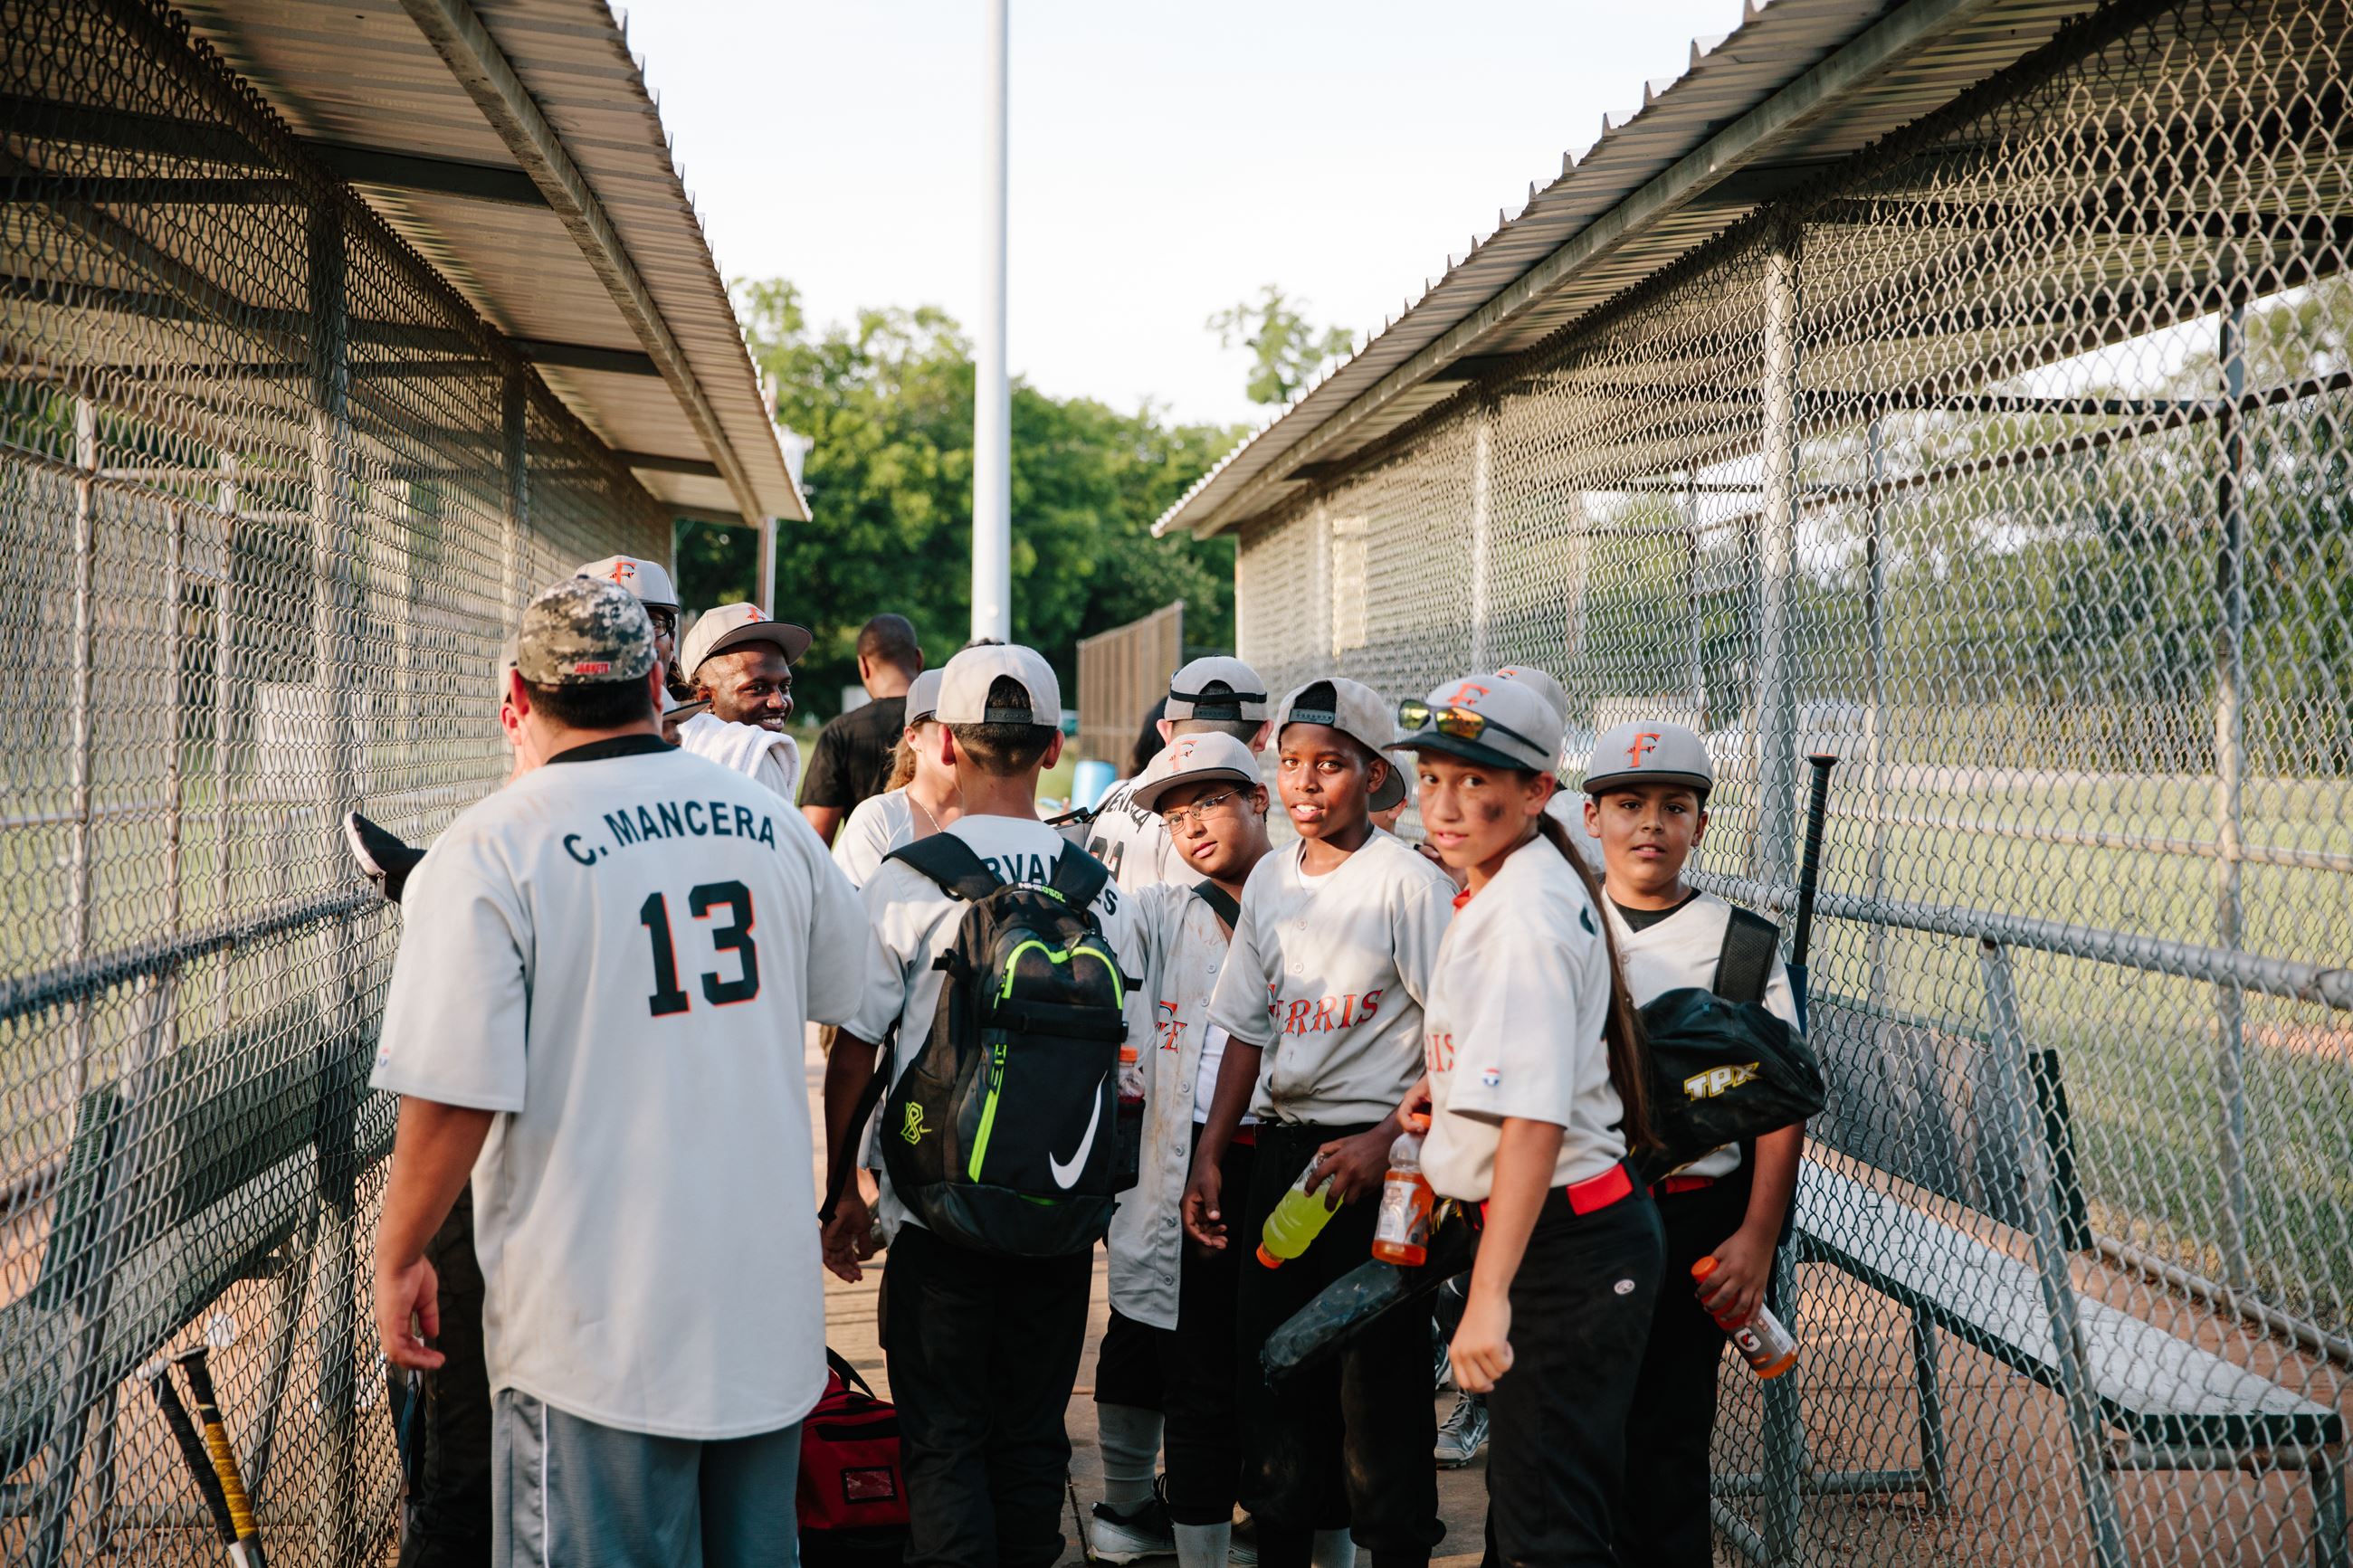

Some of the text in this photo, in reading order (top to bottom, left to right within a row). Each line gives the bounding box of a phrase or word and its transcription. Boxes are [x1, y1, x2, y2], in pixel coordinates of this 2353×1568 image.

[1167, 739, 1199, 773] F
[1625, 733, 1661, 768] F
[563, 801, 776, 866] C. MANCERA
[640, 879, 760, 1017] 13
[1684, 1062, 1759, 1101] TPX
